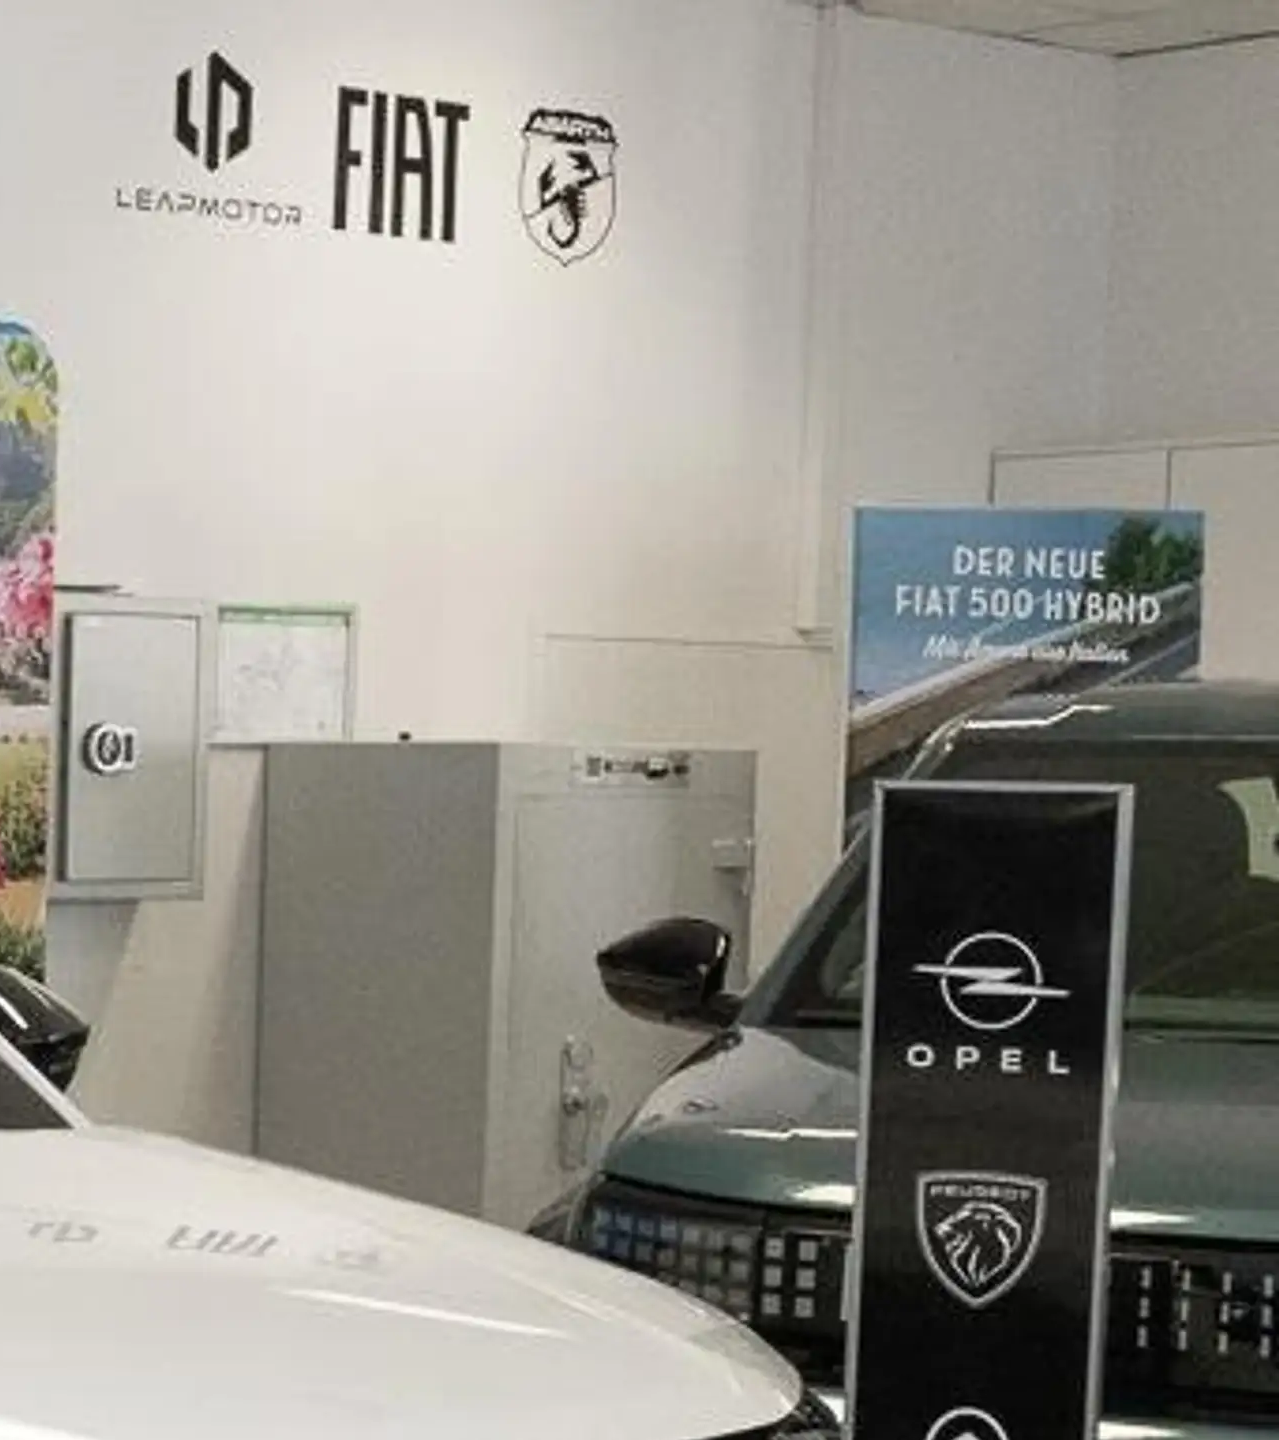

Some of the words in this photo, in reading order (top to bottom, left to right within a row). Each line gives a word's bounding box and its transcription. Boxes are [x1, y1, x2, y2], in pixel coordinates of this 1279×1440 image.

[332, 85, 470, 242] FIAT
[116, 187, 301, 226] LEAPMOTOR
[953, 545, 1014, 578] DER
[1024, 548, 1107, 580] NEUE
[895, 584, 962, 619] FIAT
[970, 587, 1034, 620] 500
[1045, 590, 1161, 625] HYBRID
[906, 1043, 1071, 1075] OPEL
